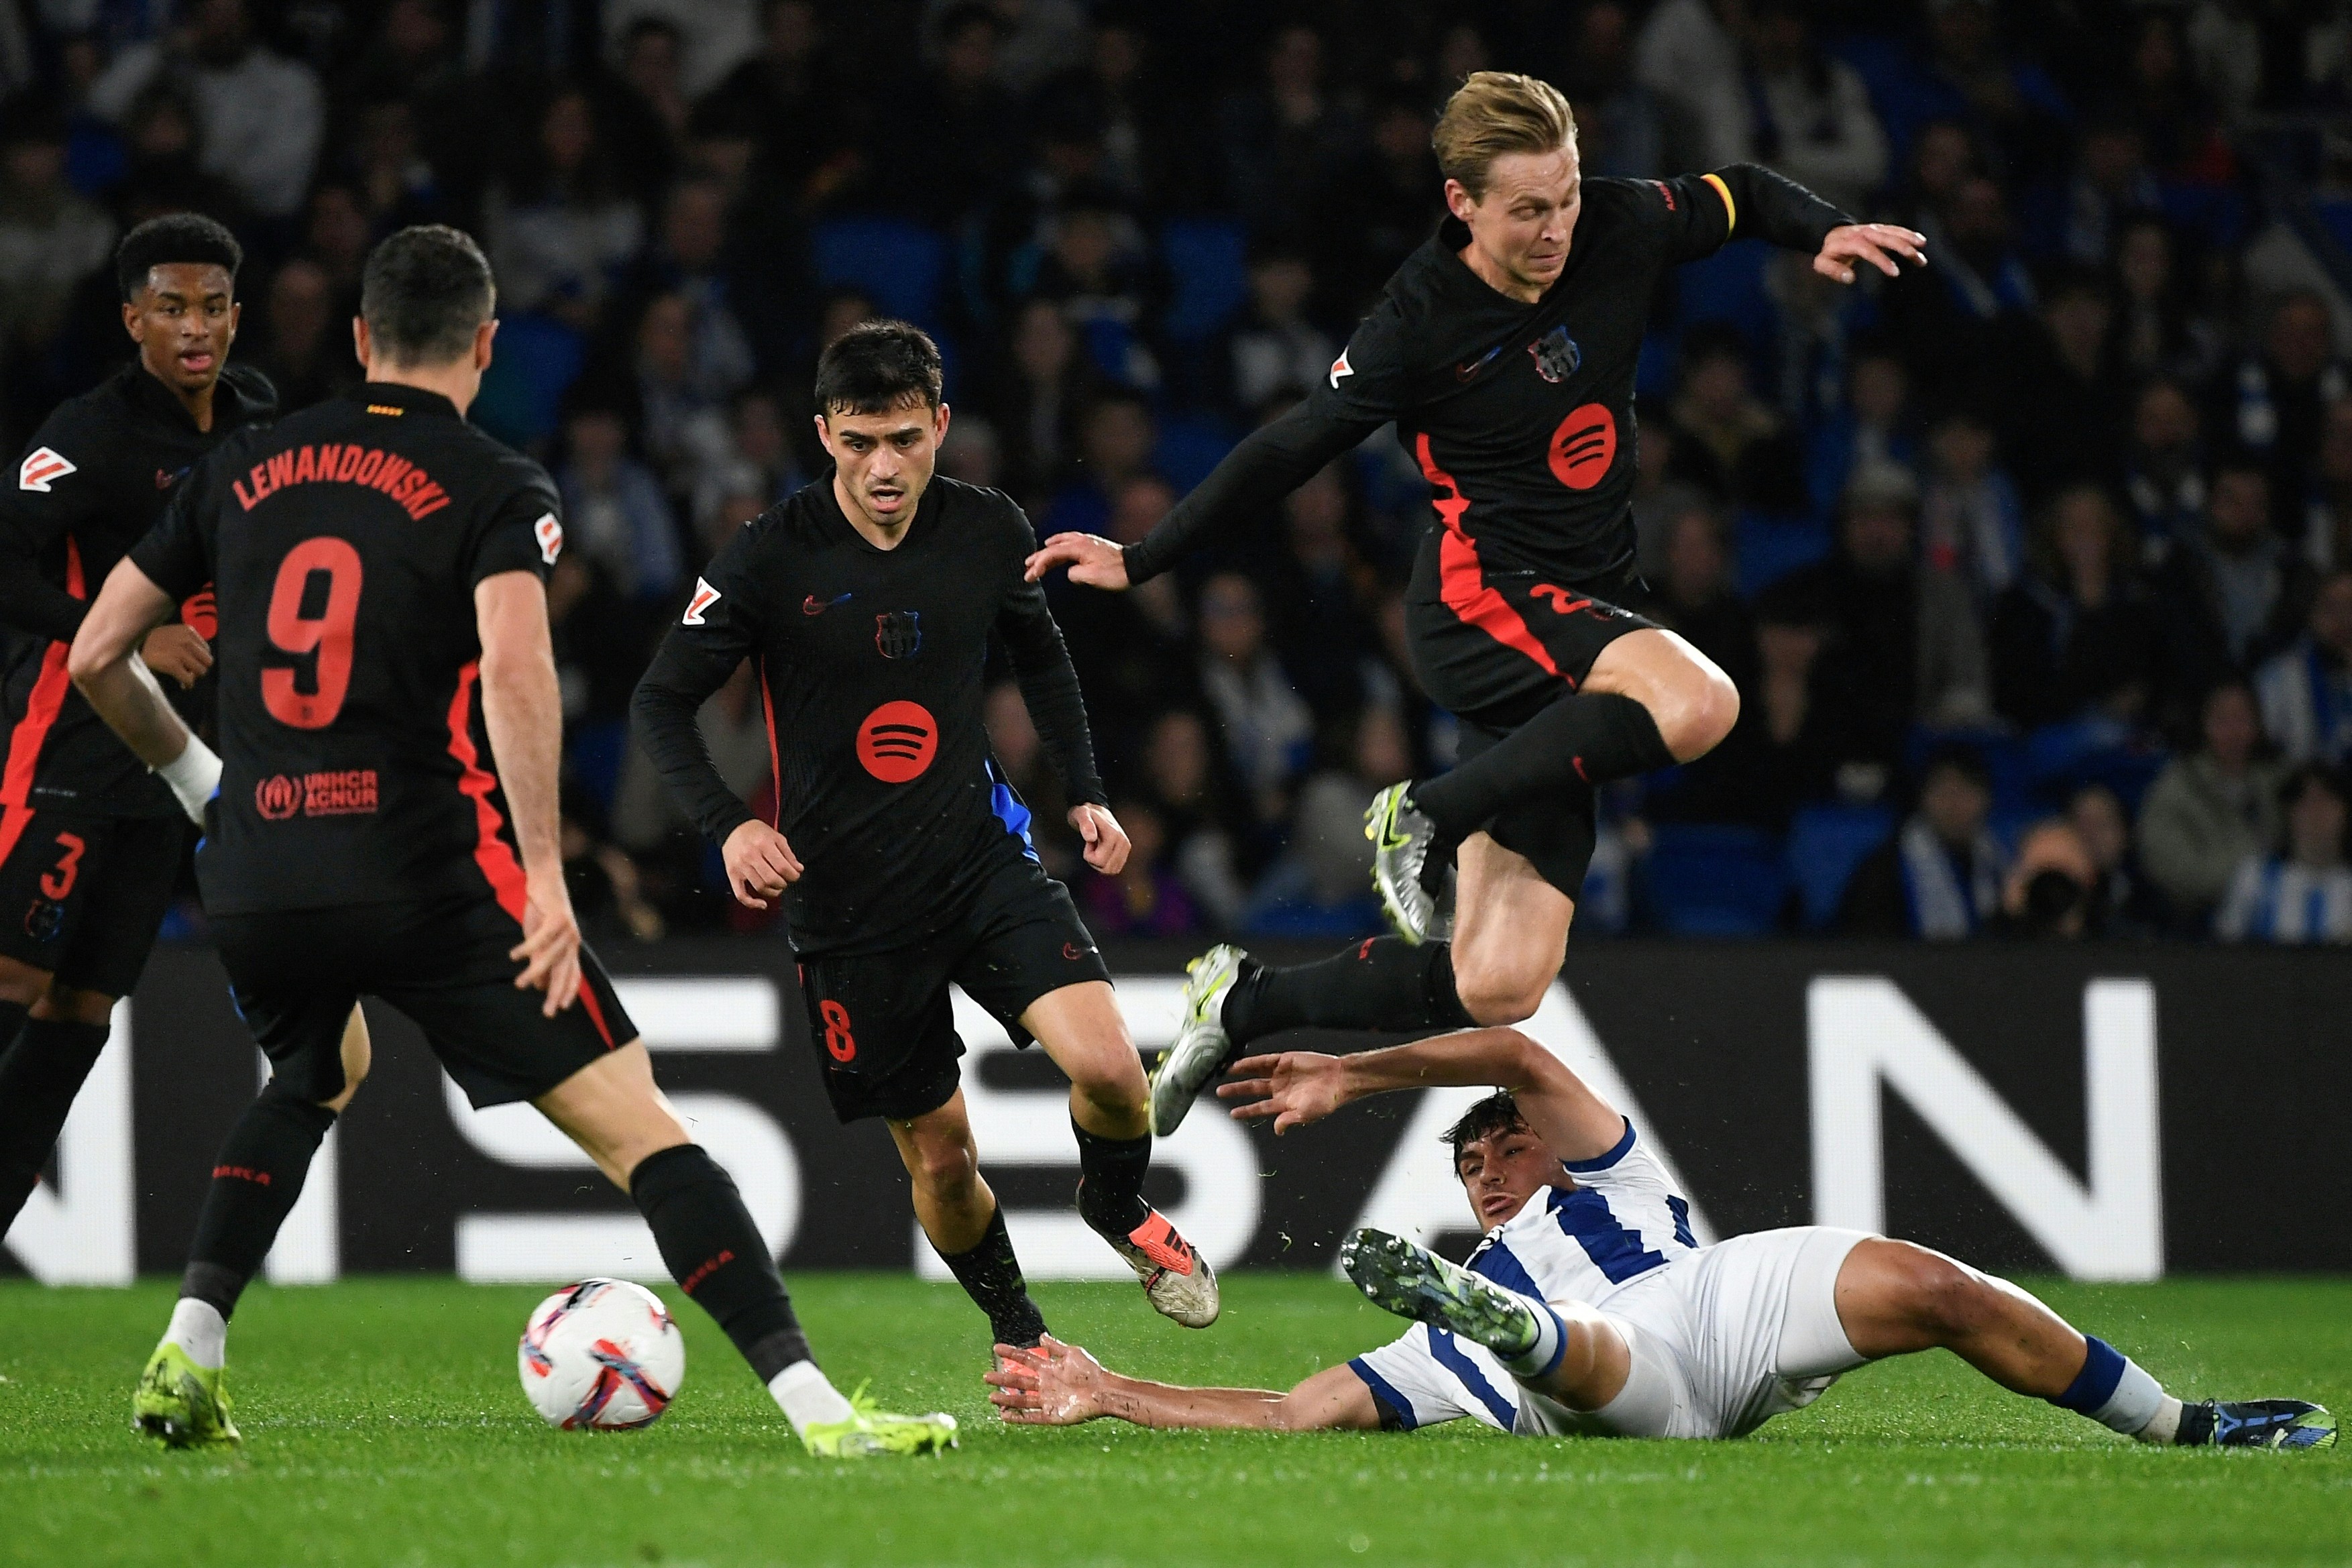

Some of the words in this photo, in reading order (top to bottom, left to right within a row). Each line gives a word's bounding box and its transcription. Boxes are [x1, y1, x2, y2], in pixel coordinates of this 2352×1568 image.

[233, 443, 451, 521] LEWANDOWSKI
[261, 536, 363, 730] 9
[40, 831, 85, 900] 3
[820, 999, 856, 1063] 8
